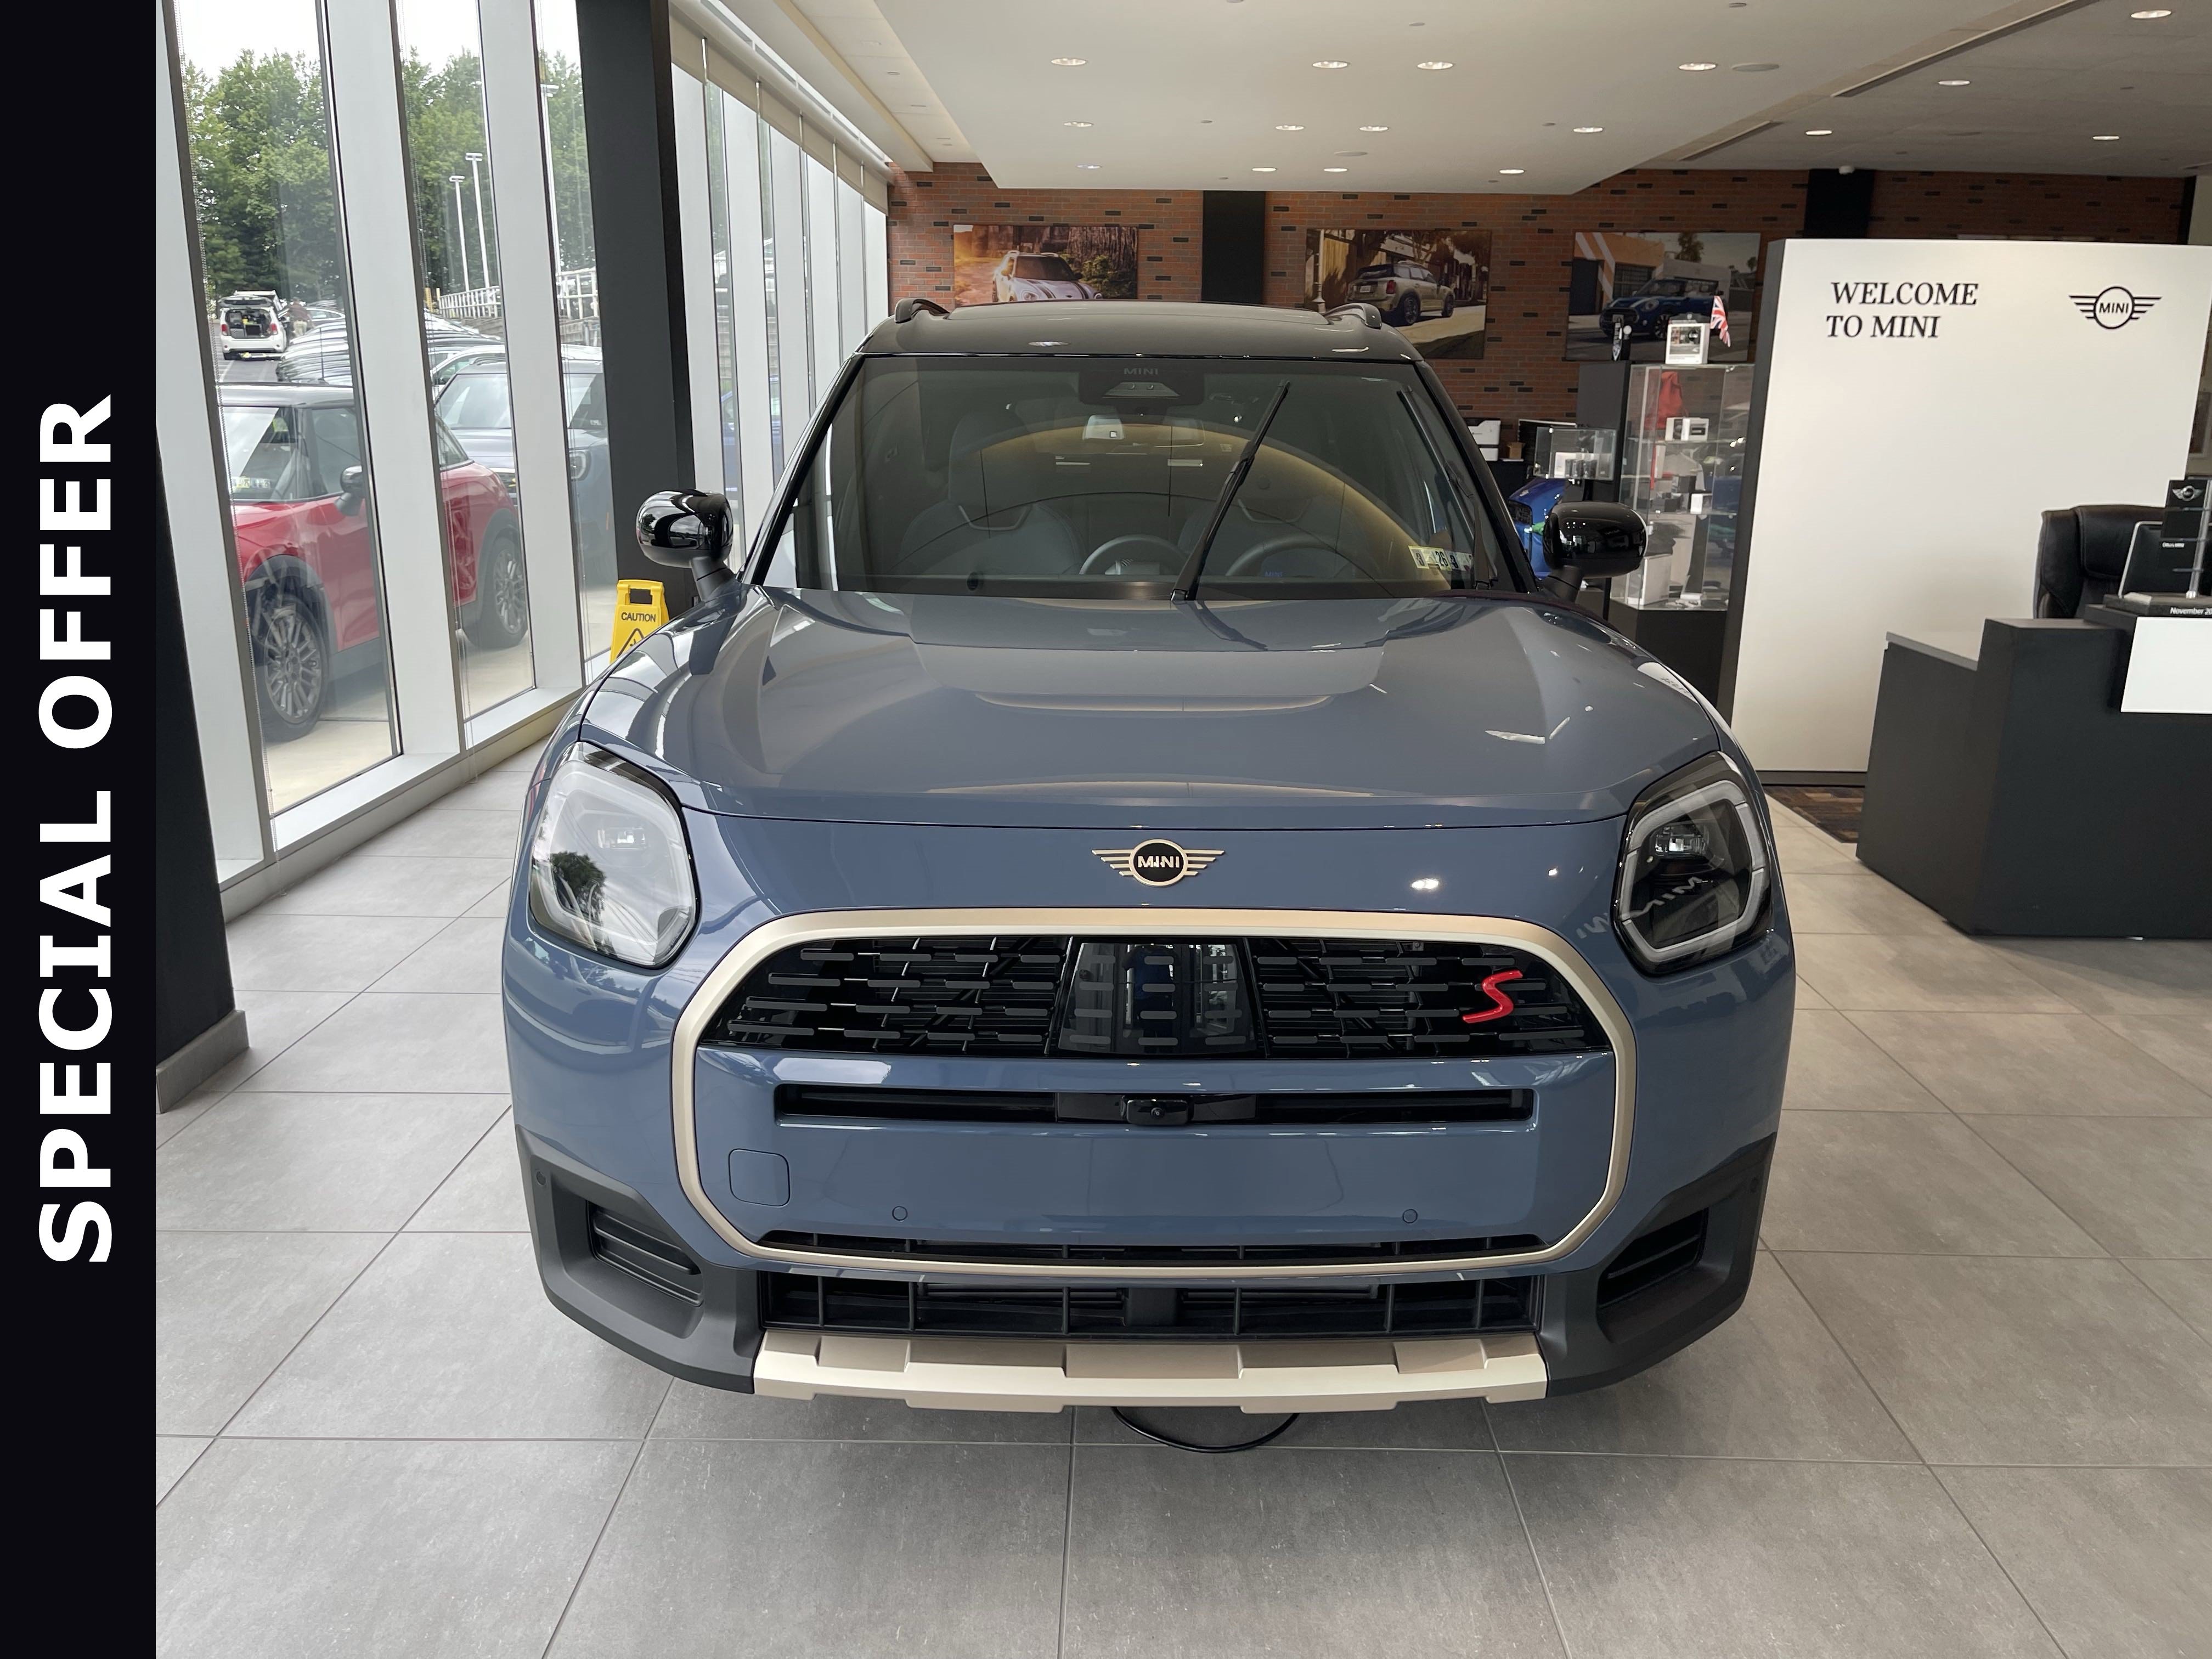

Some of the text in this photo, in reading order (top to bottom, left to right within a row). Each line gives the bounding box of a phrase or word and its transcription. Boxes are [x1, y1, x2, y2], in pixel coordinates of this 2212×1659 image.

[1831, 282, 1979, 305] WELCOME
[2099, 302, 2129, 313] MINI
[1826, 315, 1941, 338] TO MINI
[1435, 551, 1448, 567] 26
[621, 612, 656, 622] CAUTION
[2170, 606, 2204, 615] November
[1137, 855, 1180, 868] MINI
[1462, 969, 1523, 1024] S
